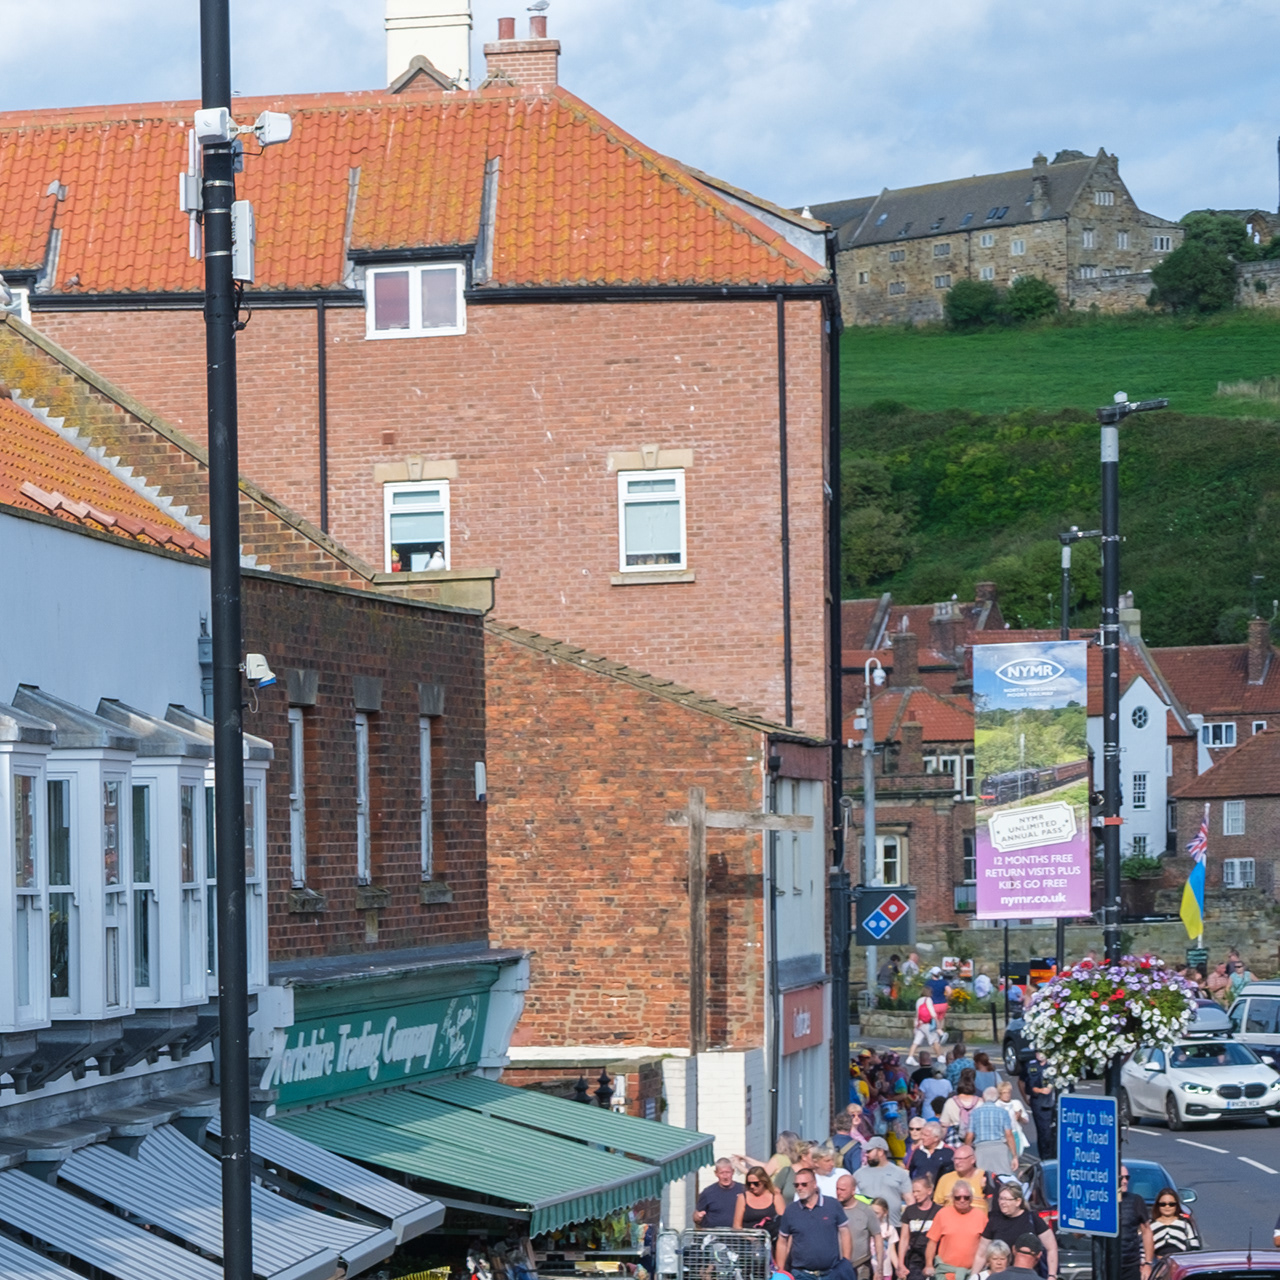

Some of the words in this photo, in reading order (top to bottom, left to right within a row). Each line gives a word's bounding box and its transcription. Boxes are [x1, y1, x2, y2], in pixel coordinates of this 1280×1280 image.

[1007, 664, 1053, 678] NYMR
[1019, 814, 1044, 823] NYMR
[1008, 820, 1057, 833] UNLIMITED
[1001, 832, 1038, 842] ANNUAL
[1041, 827, 1063, 835] PASS
[993, 856, 1003, 865] 12
[1005, 855, 1049, 865] MONTHS
[1051, 854, 1074, 863] FREE
[985, 868, 1026, 877] RETURN
[1027, 867, 1056, 876] VISITS
[1057, 866, 1081, 875] PLUS
[998, 881, 1021, 889] KIDS
[1023, 880, 1040, 888] GO
[1042, 879, 1068, 887] FREE!
[1000, 892, 1066, 907] nymr.co.uk
[337, 1021, 384, 1081] Trading
[382, 1016, 439, 1074] Company
[1062, 1108, 1084, 1127] Entry
[1087, 1111, 1097, 1123] to
[1099, 1111, 1114, 1126] the
[1067, 1127, 1083, 1144] Pier
[1087, 1129, 1109, 1145] Road
[1075, 1147, 1100, 1164] Route
[1067, 1167, 1109, 1183] restricted
[1085, 1187, 1109, 1203] yards
[1075, 1205, 1101, 1221] ahead
